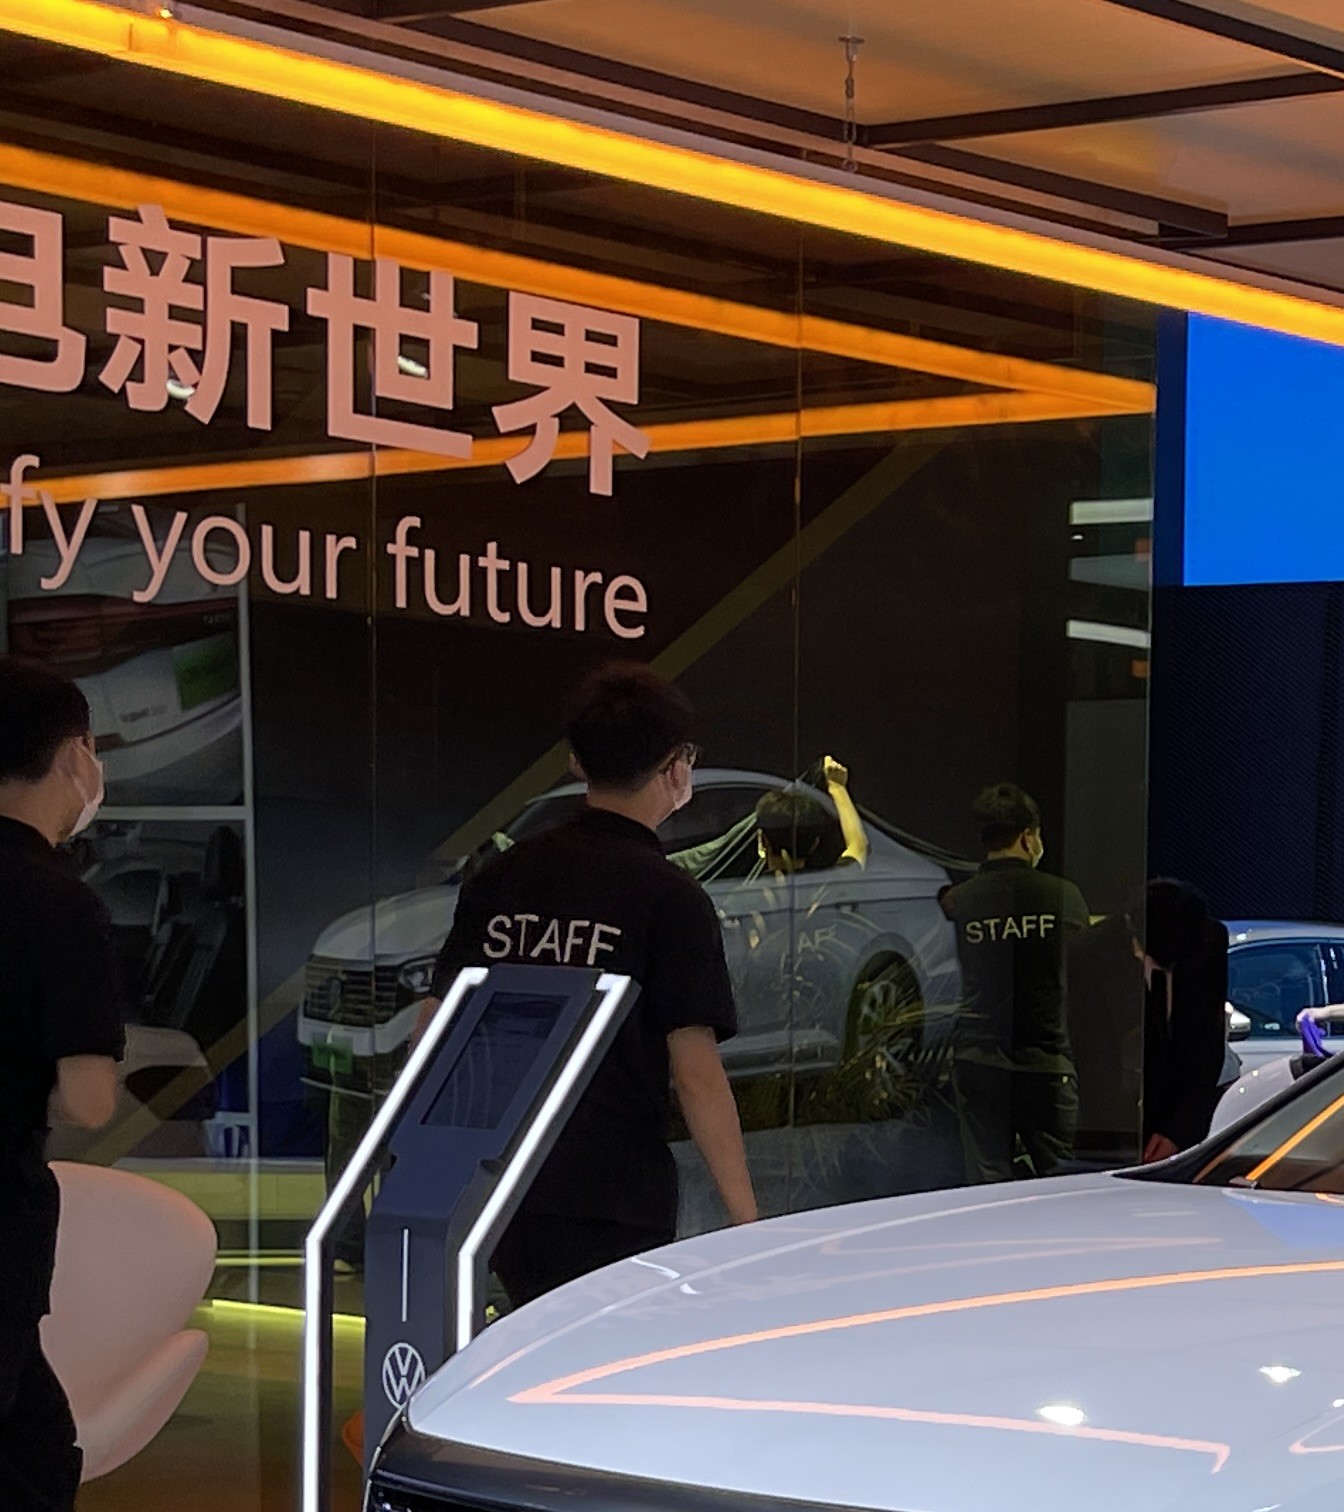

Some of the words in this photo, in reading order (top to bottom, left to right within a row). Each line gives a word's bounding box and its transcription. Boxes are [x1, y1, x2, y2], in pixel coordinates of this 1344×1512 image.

[131, 503, 357, 602] your
[386, 515, 648, 640] future
[483, 914, 622, 966] STAFF
[966, 915, 1055, 943] STAFF
